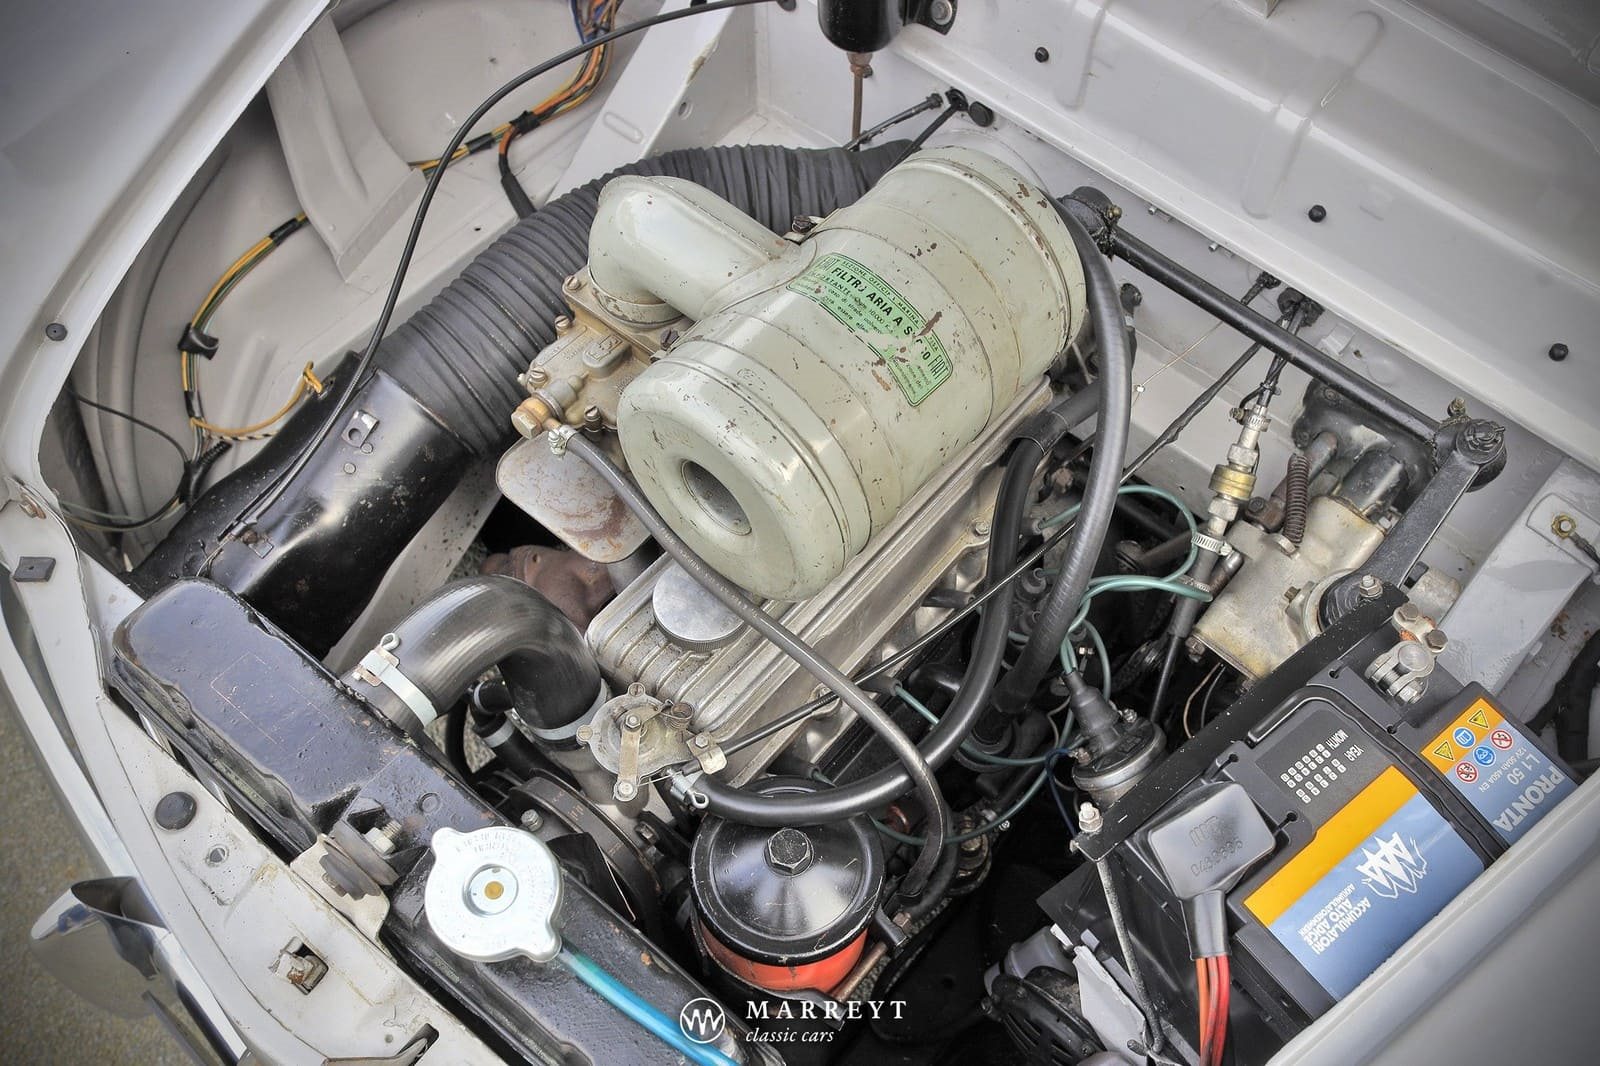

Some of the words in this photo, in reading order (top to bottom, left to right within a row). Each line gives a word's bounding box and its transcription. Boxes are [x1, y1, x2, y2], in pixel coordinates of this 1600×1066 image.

[866, 292, 893, 316] ARIA
[893, 316, 903, 326] A
[928, 354, 948, 380] FIAT
[1325, 728, 1347, 749] MONTH
[1343, 743, 1364, 762] YEAR
[1520, 754, 1540, 771] L1
[1505, 766, 1525, 785] 50
[1492, 765, 1563, 832] PRONTA
[1327, 897, 1354, 924] ALTO
[1302, 917, 1332, 946] ADIGE
[1310, 896, 1372, 955] ACCUMULATORI
